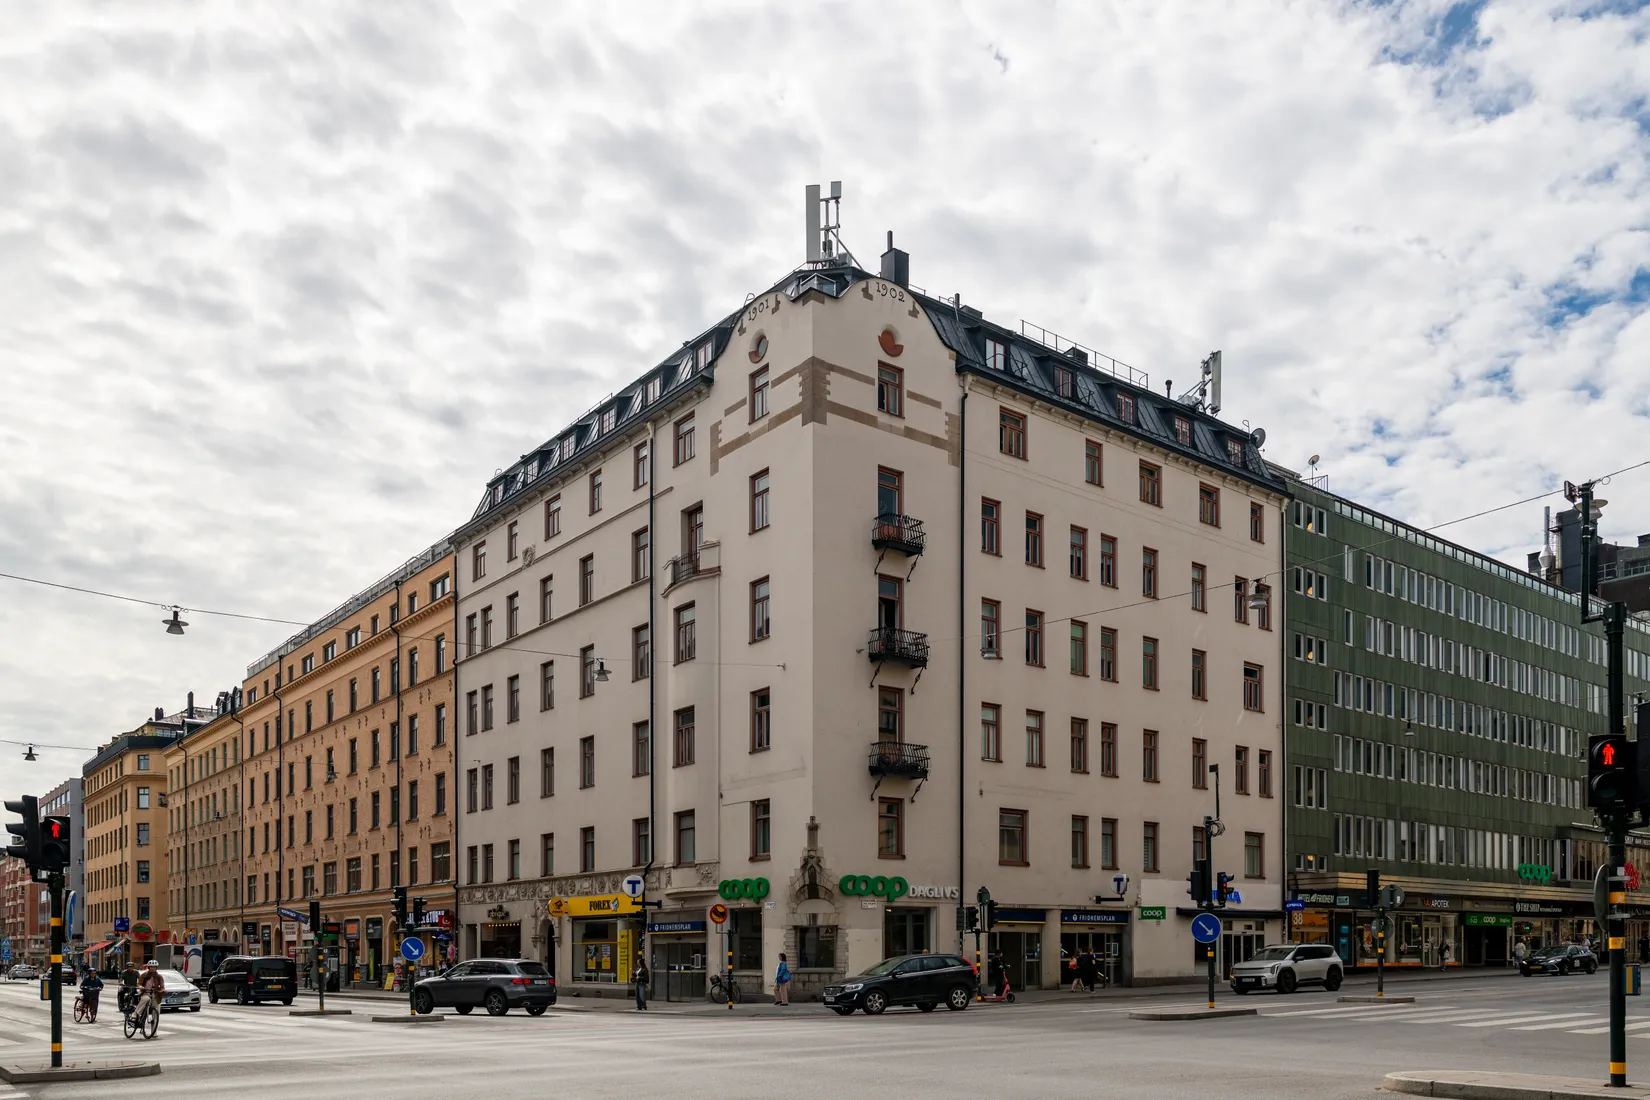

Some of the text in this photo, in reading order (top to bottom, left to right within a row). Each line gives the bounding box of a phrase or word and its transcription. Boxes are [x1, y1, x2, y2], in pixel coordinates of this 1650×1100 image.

[876, 281, 906, 302] 1902
[748, 301, 770, 321] 1901
[1518, 863, 1551, 885] coop
[627, 880, 640, 894] T
[718, 877, 770, 904] coop
[839, 875, 959, 902] coop DAGLIVS
[589, 899, 611, 911] FOREX
[1431, 899, 1450, 908] APOTEK
[1079, 914, 1116, 922] FRIDHEMSPLAN
[1142, 909, 1163, 918] coop
[1293, 912, 1303, 925] 38
[1483, 916, 1496, 925] coop
[659, 923, 692, 932] FRIDHEMSPLAN
